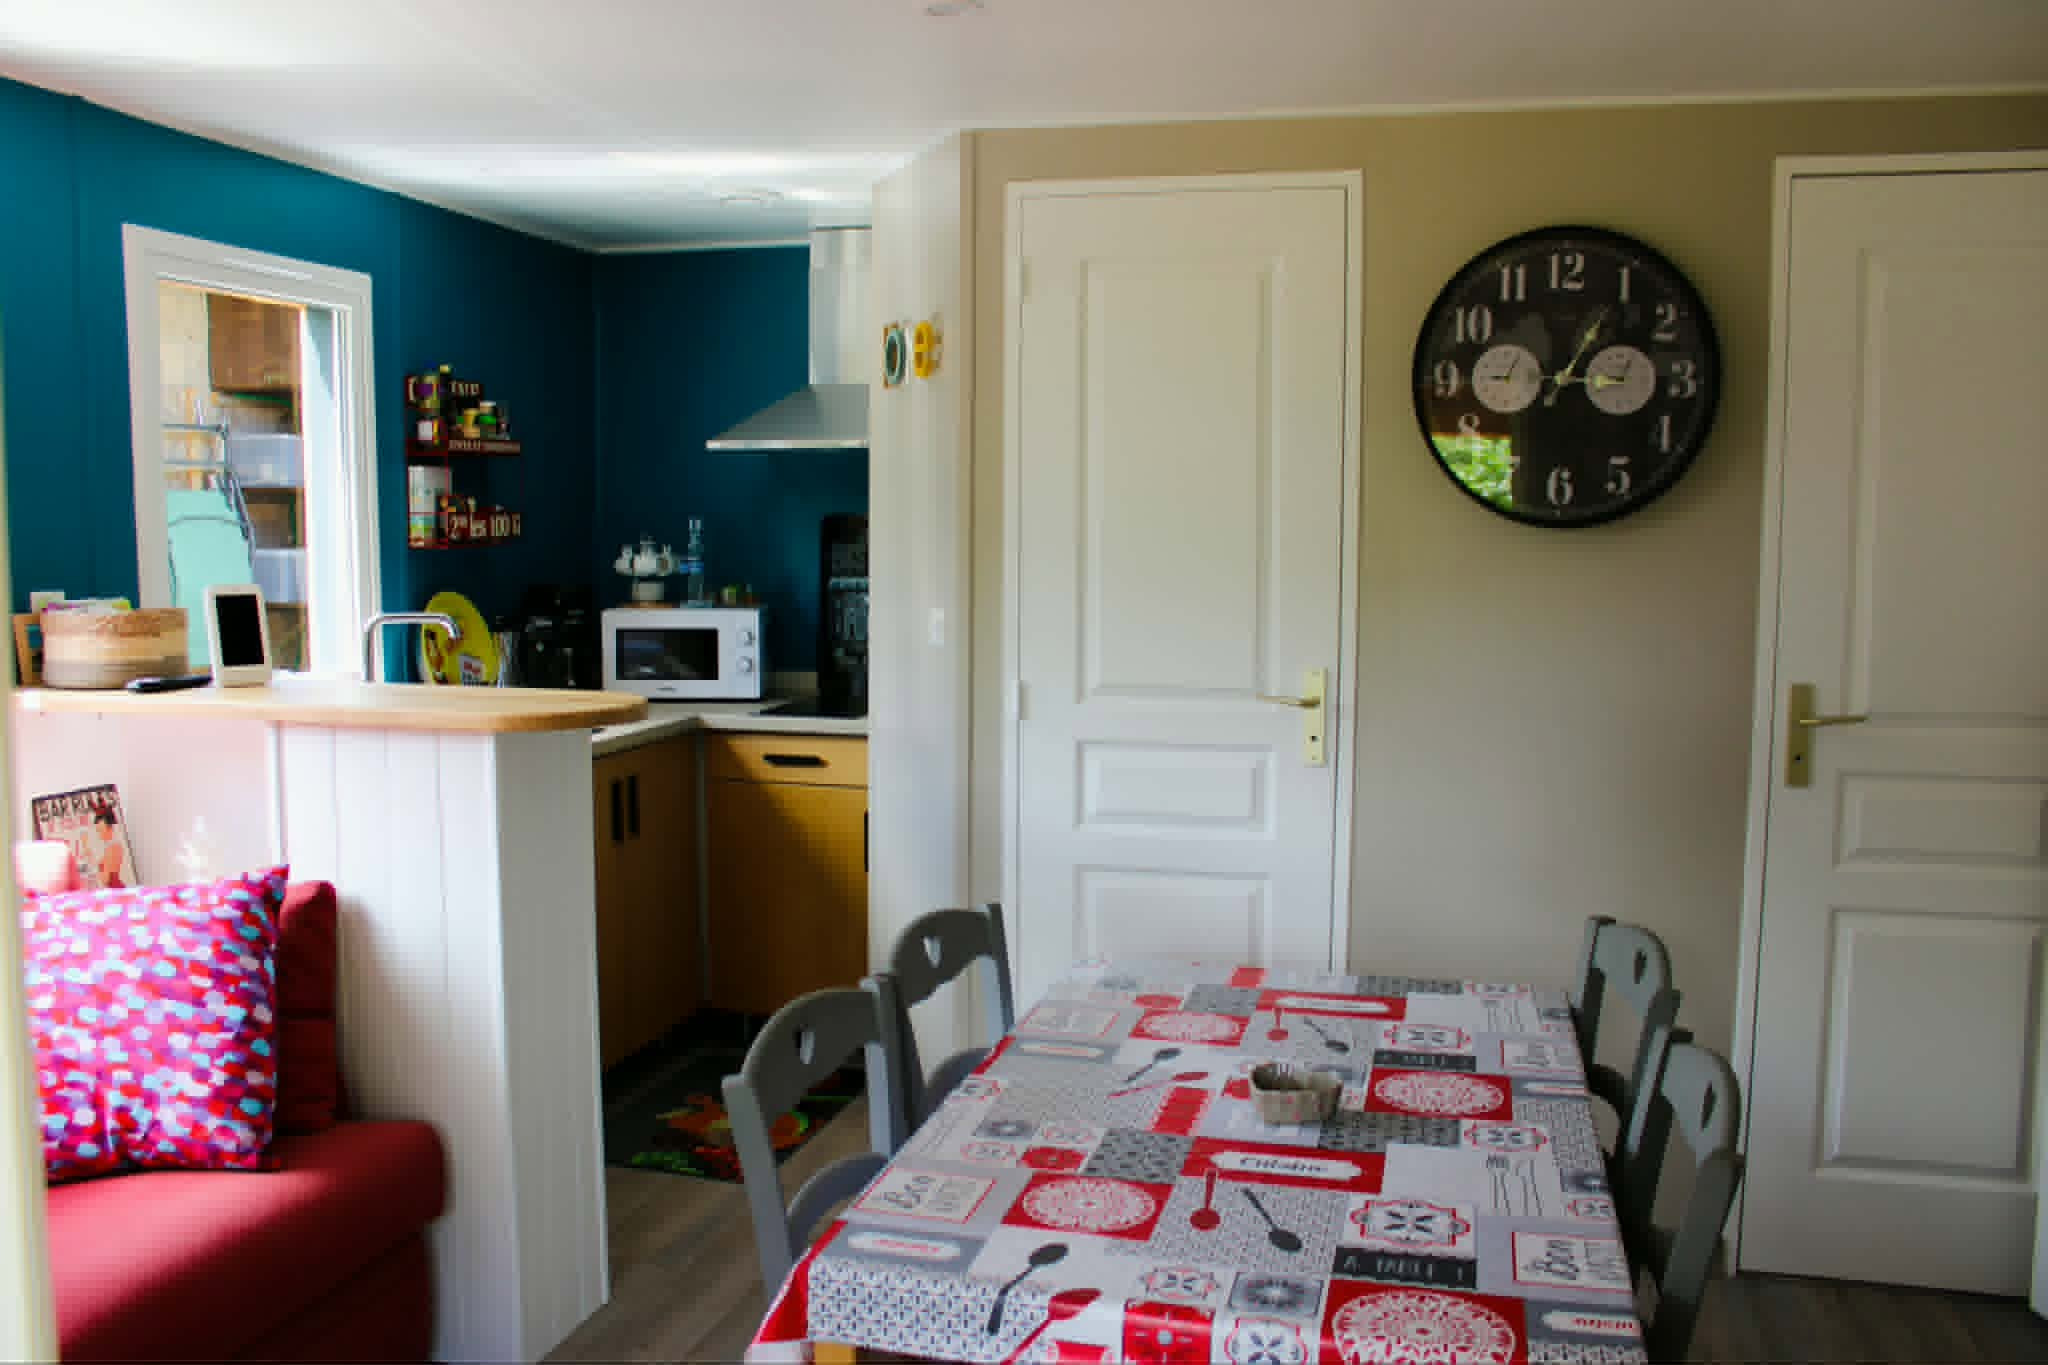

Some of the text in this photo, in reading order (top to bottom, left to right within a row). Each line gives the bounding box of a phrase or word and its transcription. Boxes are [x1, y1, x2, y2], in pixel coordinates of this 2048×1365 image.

[1500, 263, 1526, 302] 11
[1549, 252, 1585, 291] 12
[1618, 265, 1631, 303] 1
[1454, 304, 1492, 343] 10
[1653, 303, 1678, 342] 2
[1433, 359, 1460, 398] 9
[1669, 359, 1697, 399] 3
[1546, 464, 1574, 505] 6
[1606, 455, 1632, 496] 5
